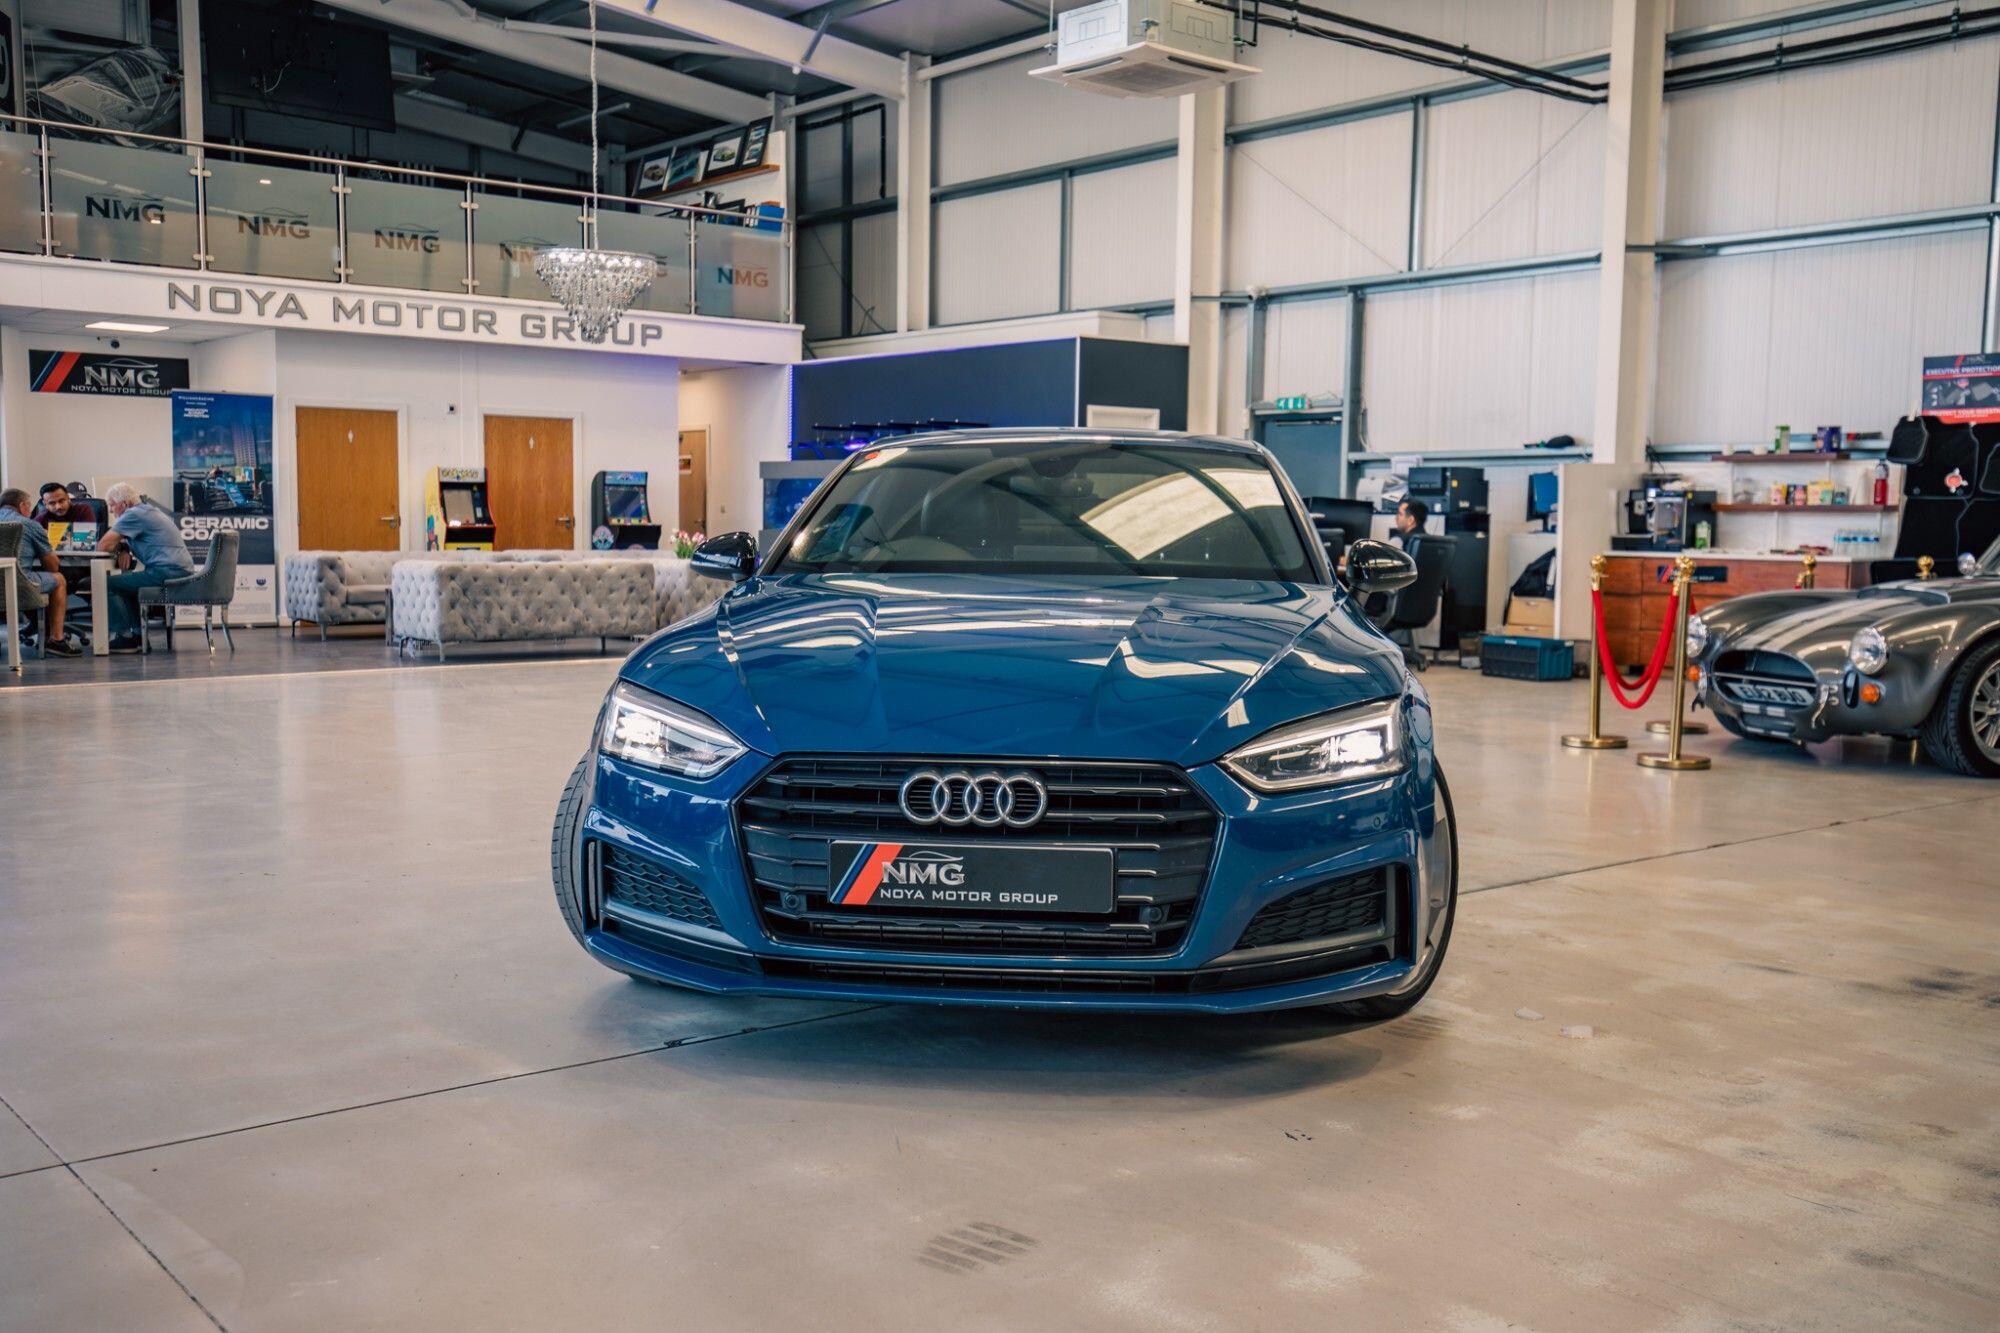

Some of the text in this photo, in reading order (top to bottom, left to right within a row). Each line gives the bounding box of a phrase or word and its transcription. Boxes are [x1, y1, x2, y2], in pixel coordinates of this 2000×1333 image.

[85, 196, 166, 224] NMG
[238, 215, 311, 239] NMG
[374, 229, 440, 253] NMG
[717, 267, 769, 288] NMG
[168, 282, 308, 320] NOYA
[332, 296, 498, 336] MOTOR
[83, 366, 160, 388] NMG
[71, 384, 98, 392] NOYA
[102, 387, 135, 395] MOTOR
[180, 516, 269, 530] CERAMIC
[881, 861, 966, 886] NMG
[880, 888, 1058, 904] NOYA MOTOR GROUP
